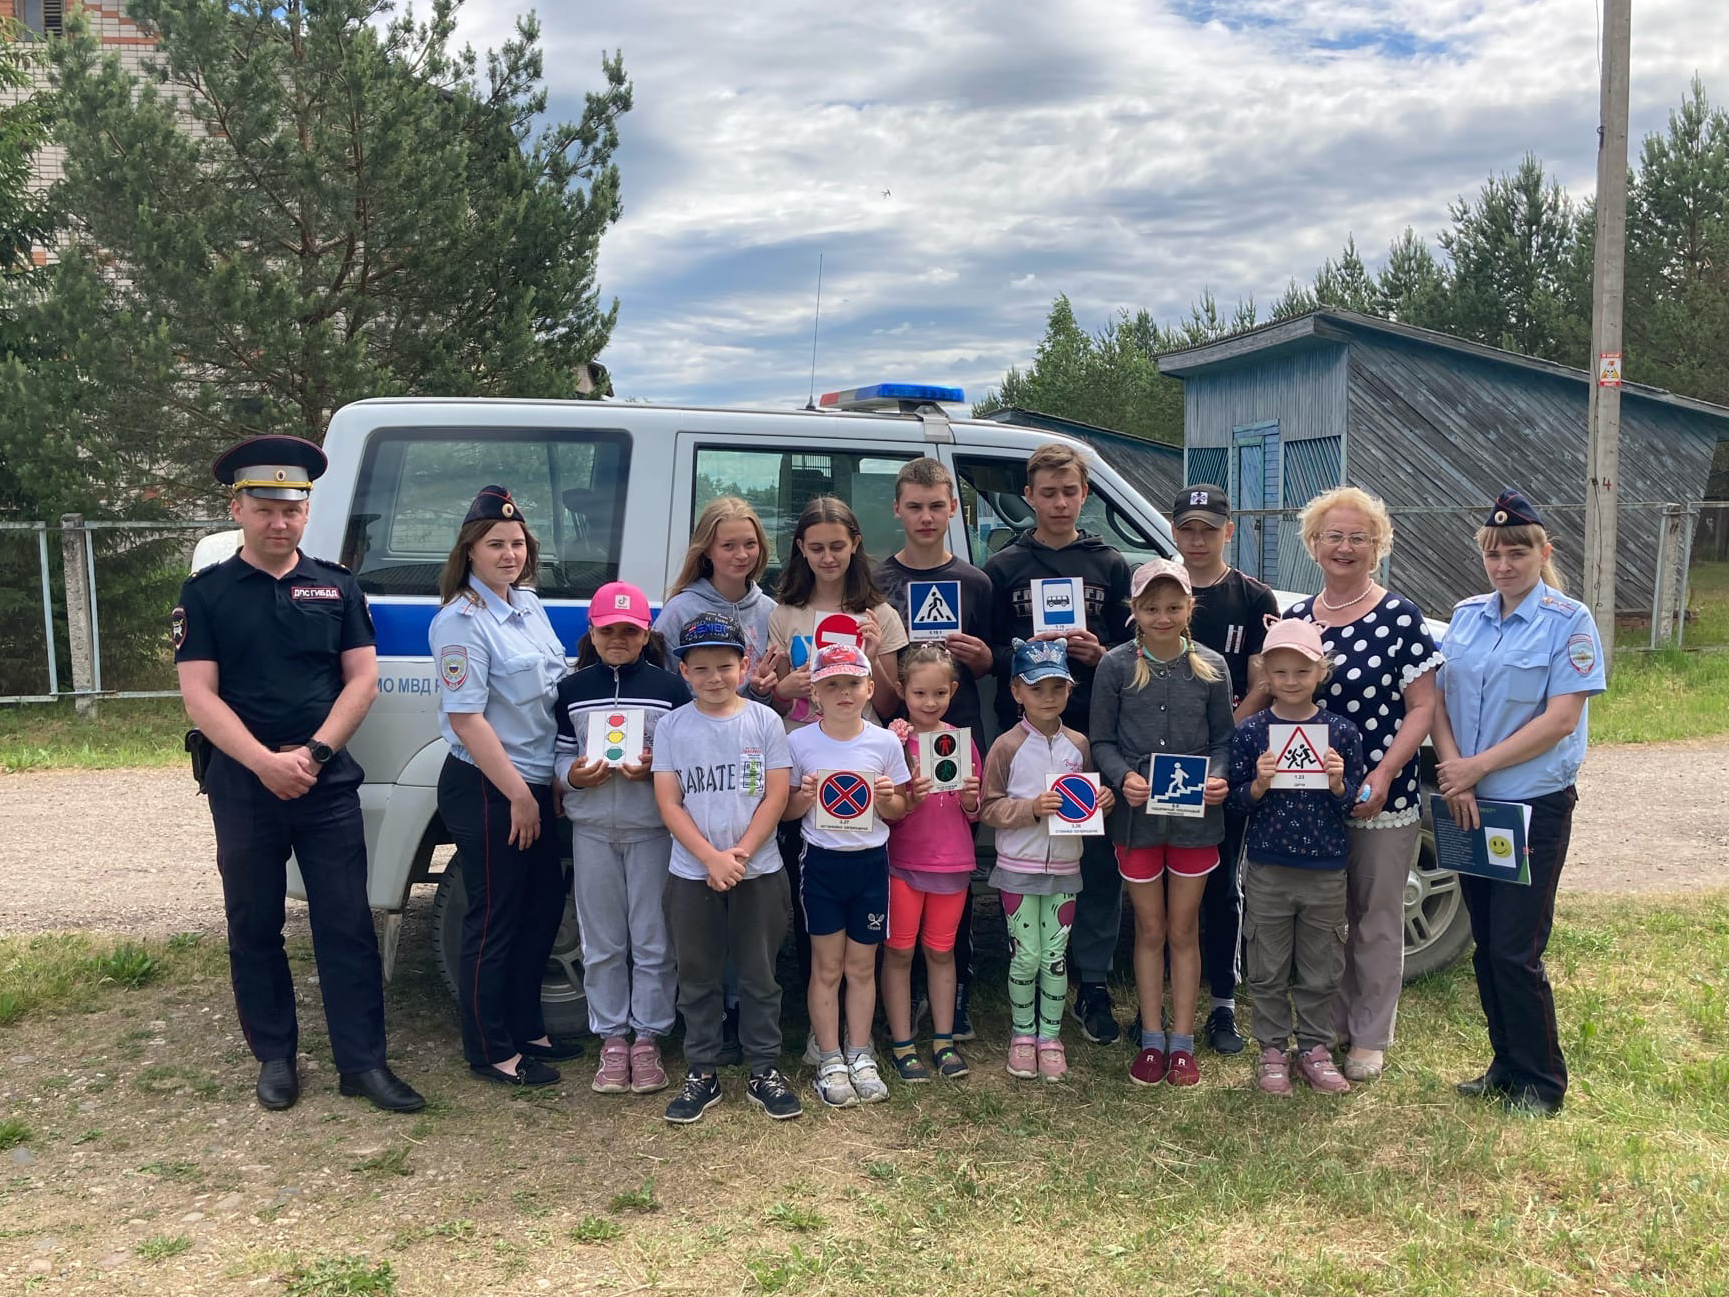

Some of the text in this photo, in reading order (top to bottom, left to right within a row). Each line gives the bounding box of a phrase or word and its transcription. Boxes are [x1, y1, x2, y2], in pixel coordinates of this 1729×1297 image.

[294, 588, 338, 598] ДПС ГИБДД
[398, 678, 431, 696] МВД
[1146, 1054, 1154, 1062] R
[1178, 1057, 1186, 1066] R
